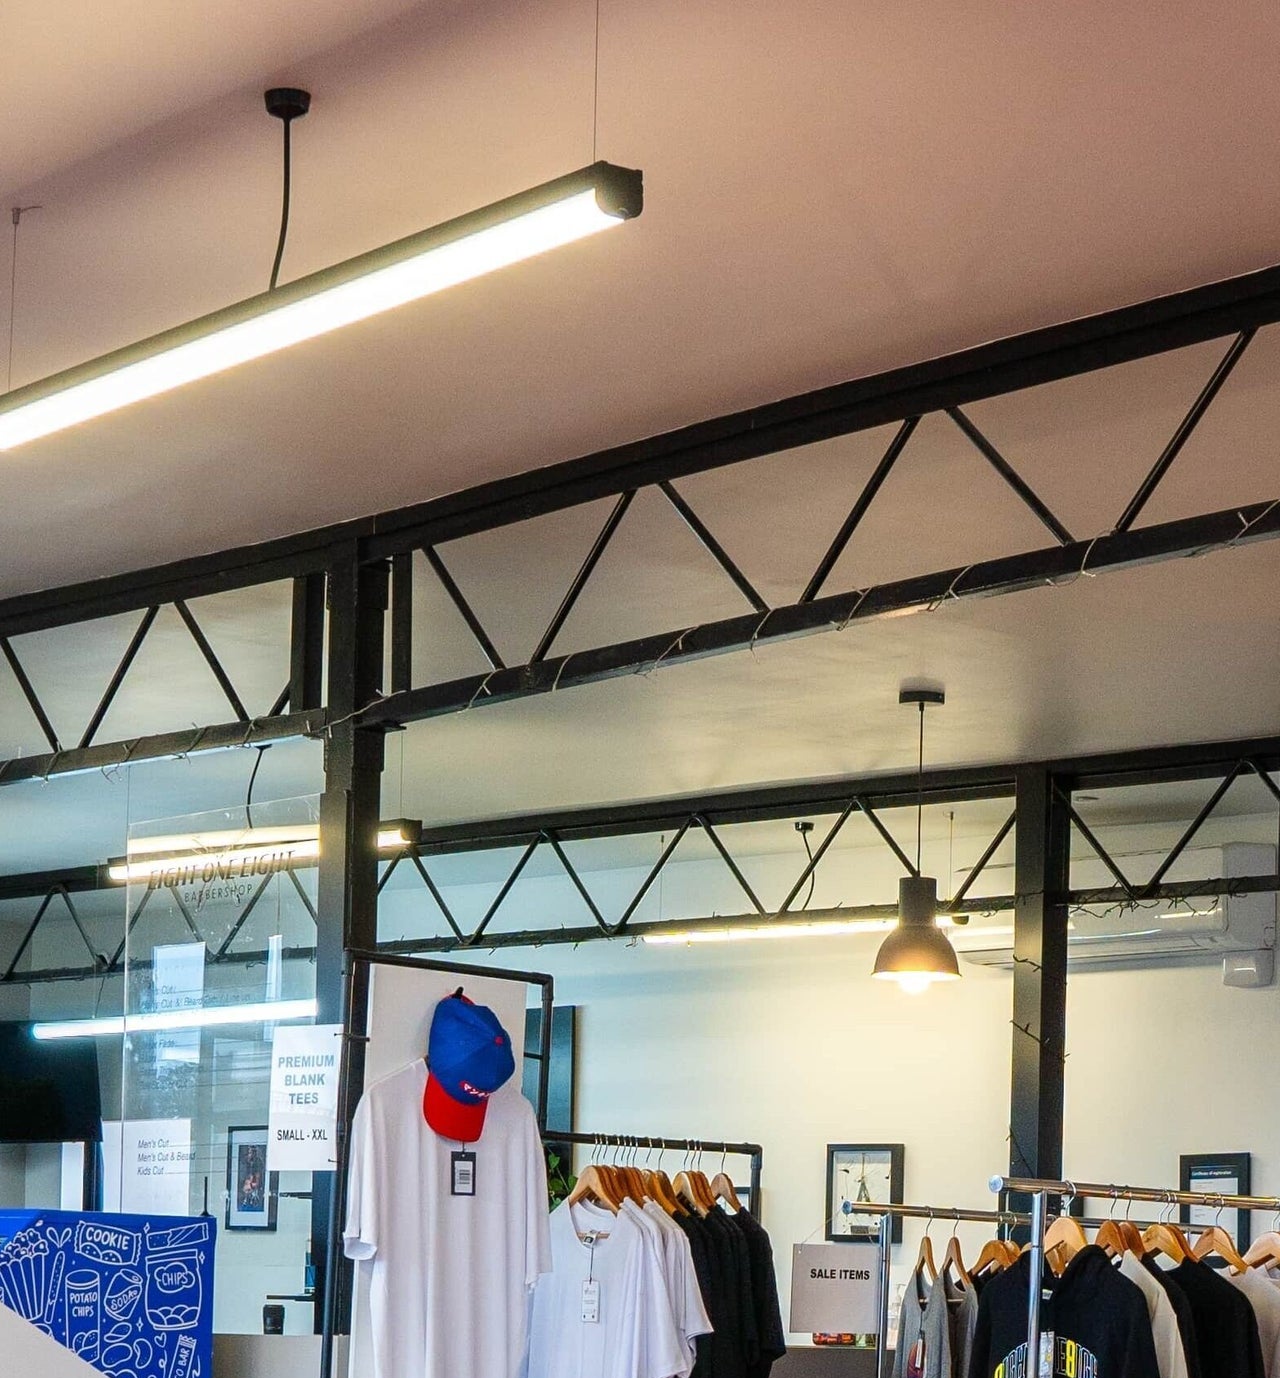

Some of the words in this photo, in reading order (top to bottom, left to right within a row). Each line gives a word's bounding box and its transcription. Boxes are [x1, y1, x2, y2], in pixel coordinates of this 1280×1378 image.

[147, 865, 198, 890] EIGHT
[201, 858, 239, 884] ONE
[239, 850, 296, 878] EIGHT
[184, 883, 253, 903] BARBERSHOP
[278, 1054, 335, 1068] PREMIUM
[284, 1073, 326, 1087] BLANK
[288, 1092, 319, 1105] TEES
[277, 1129, 305, 1141] SMALL
[311, 1128, 328, 1141] XXL
[157, 1138, 170, 1148] Cut
[157, 1152, 169, 1161] Cut
[137, 1166, 152, 1176] Kids
[152, 1165, 164, 1175] Cut
[85, 1226, 130, 1250] COOKIE
[161, 1272, 188, 1287] CHIPS
[810, 1268, 837, 1279] SALE
[839, 1269, 871, 1280] ITEMS
[70, 1291, 98, 1304] POTATO
[110, 1289, 135, 1311] SODA
[72, 1305, 94, 1318] CHIPS
[178, 1347, 190, 1366] BAR
